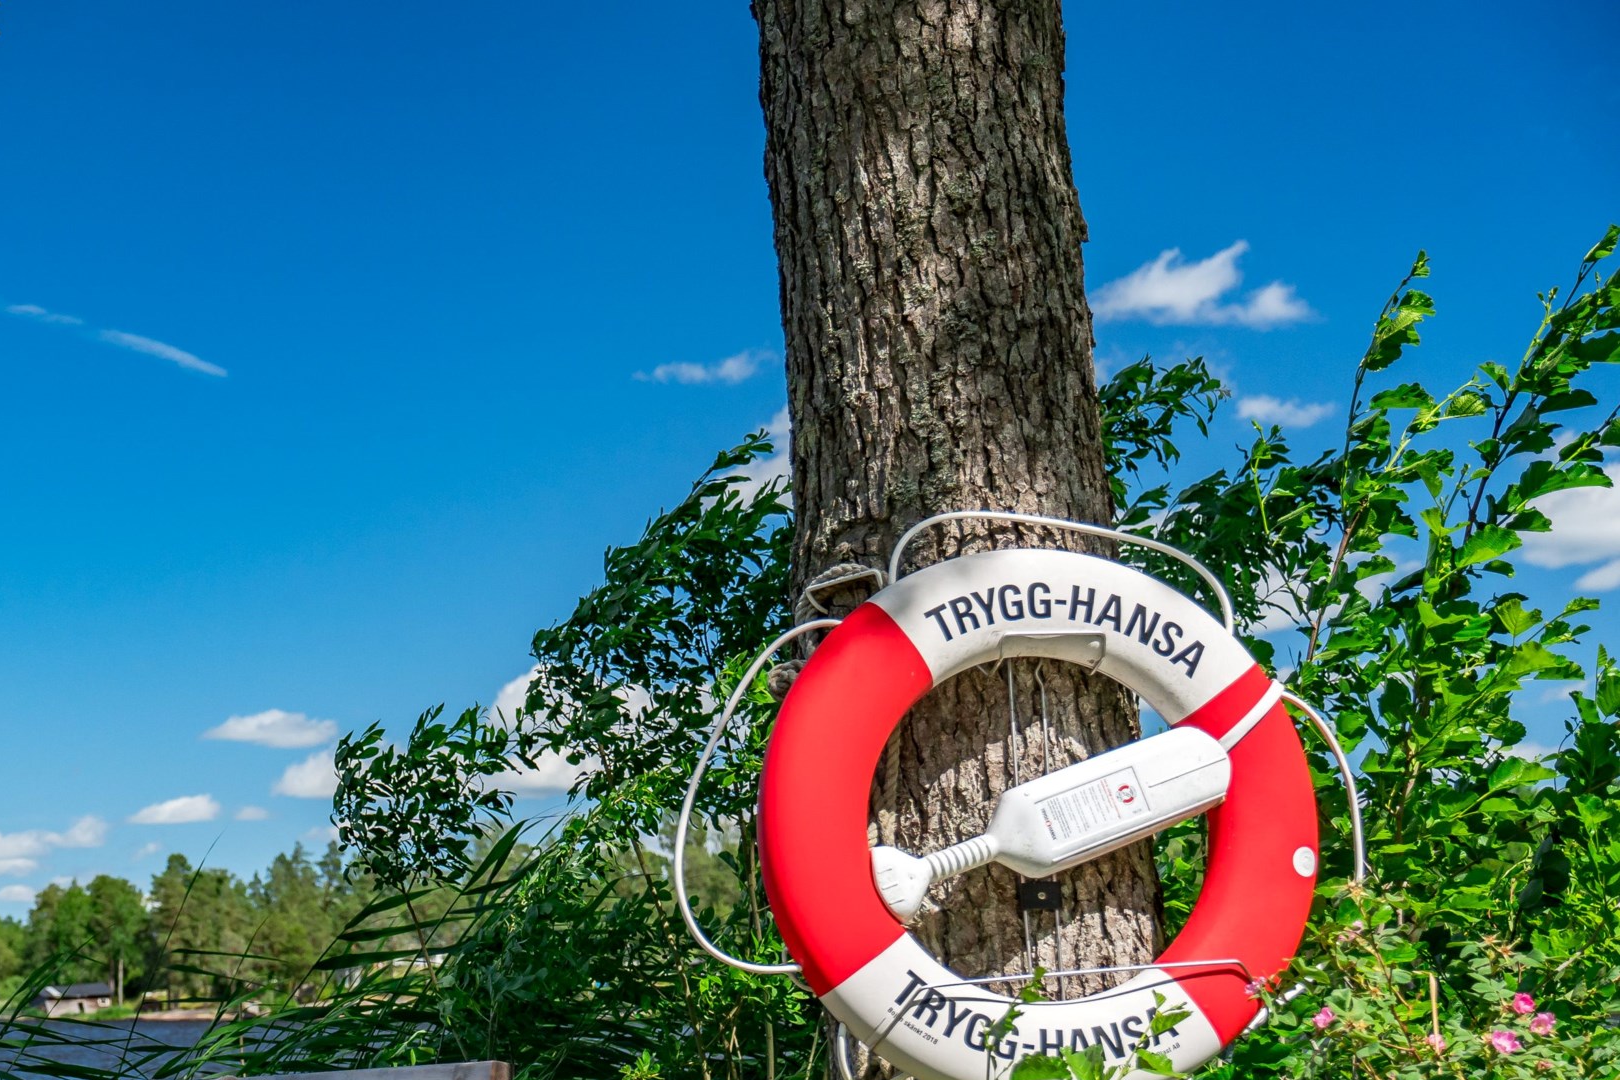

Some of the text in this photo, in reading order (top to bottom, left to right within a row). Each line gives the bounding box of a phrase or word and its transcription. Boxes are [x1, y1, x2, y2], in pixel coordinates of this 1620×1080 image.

[924, 582, 1205, 679] TRYGG-HANSA
[887, 1007, 939, 1045] Bojn skänkt 2018
